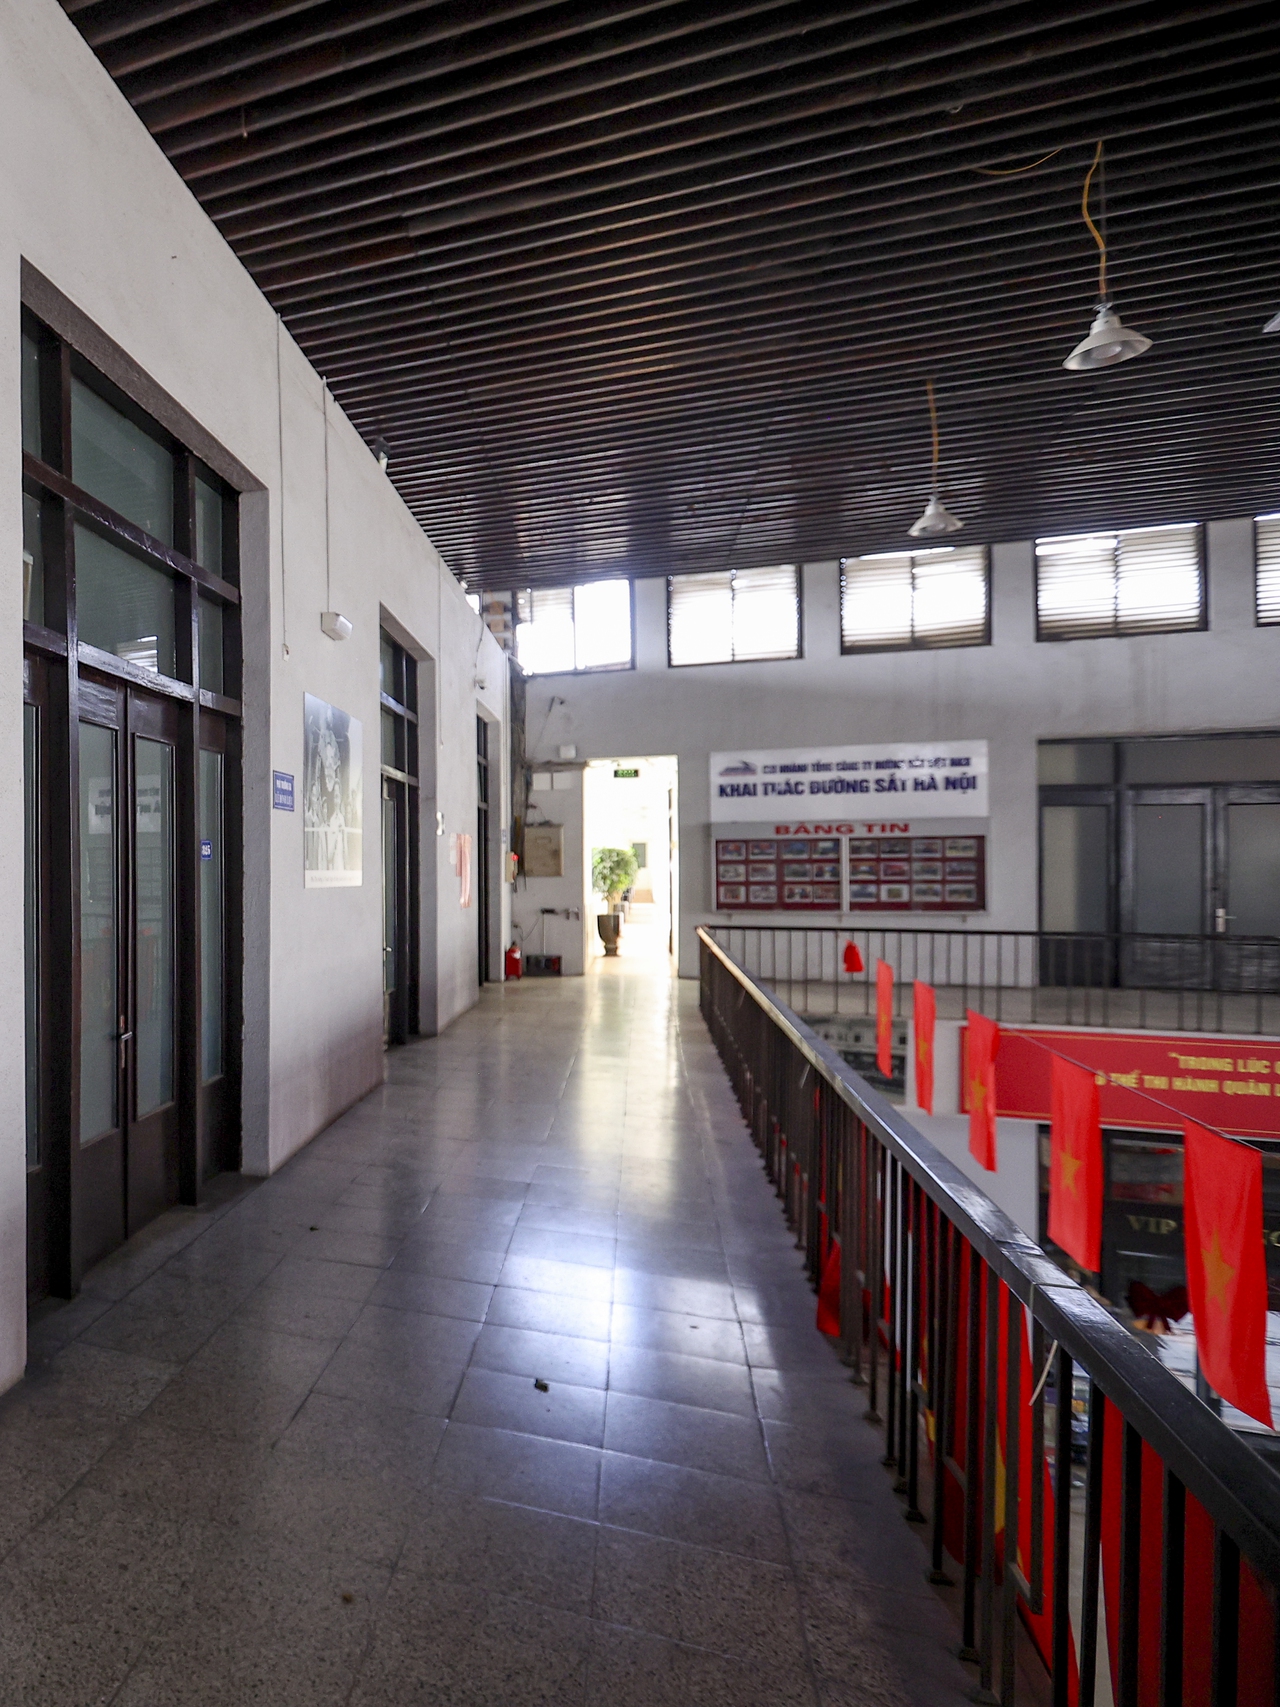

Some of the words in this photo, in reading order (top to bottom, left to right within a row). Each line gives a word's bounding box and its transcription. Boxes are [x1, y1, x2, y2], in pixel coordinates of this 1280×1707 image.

[719, 783, 758, 797] KHAI
[810, 775, 869, 794] ĐƯỜNG
[875, 772, 907, 792] SẮT
[913, 773, 938, 791] HÀ
[944, 772, 977, 794] NỘI
[863, 822, 910, 834] TIN
[1126, 1214, 1178, 1235] VIP
